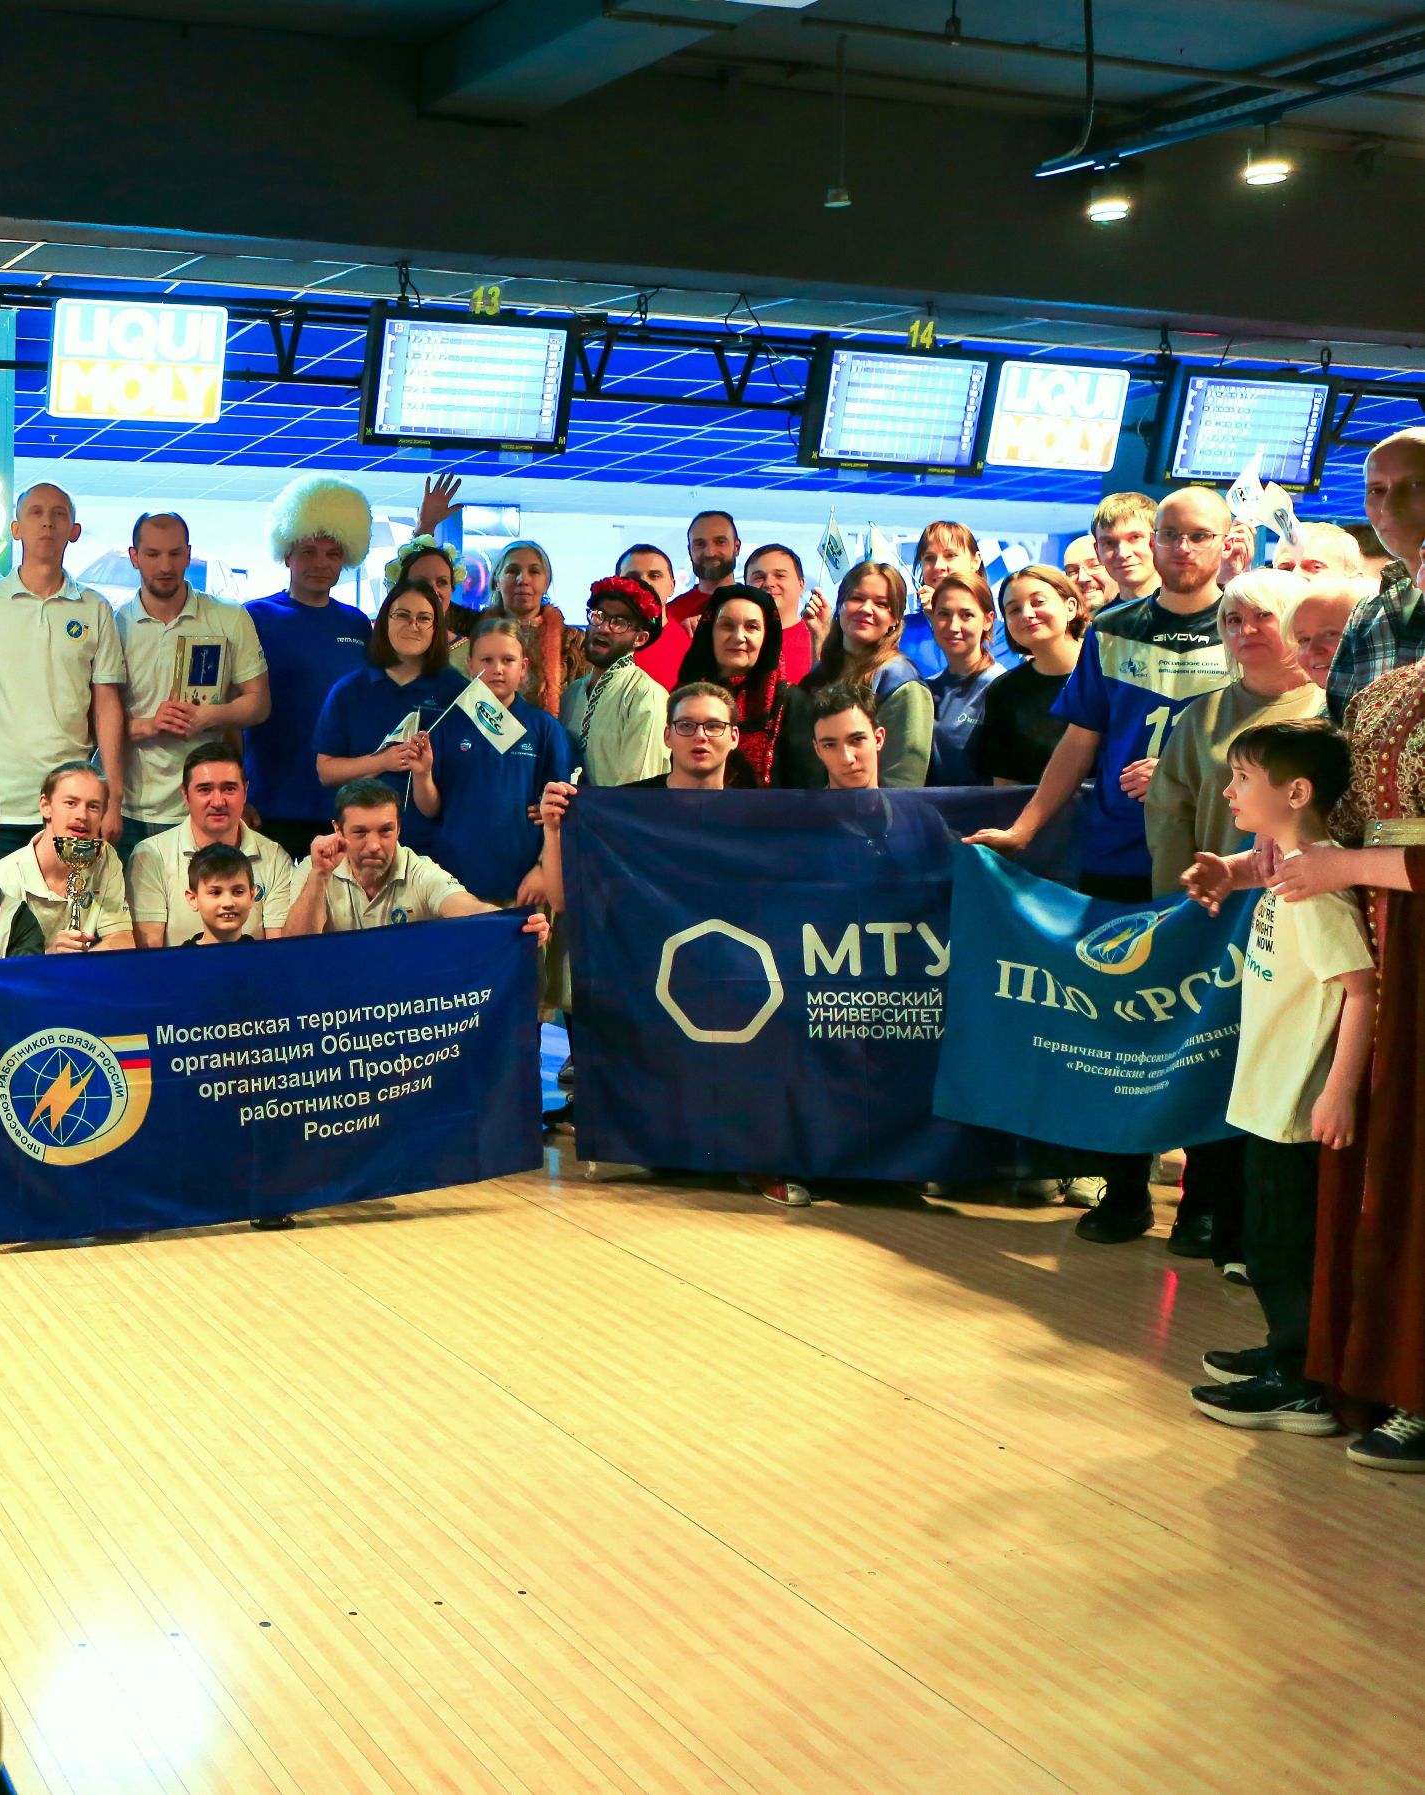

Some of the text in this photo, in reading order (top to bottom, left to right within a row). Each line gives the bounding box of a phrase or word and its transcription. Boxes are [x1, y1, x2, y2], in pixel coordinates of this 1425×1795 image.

[471, 285, 502, 316] 13
[64, 304, 219, 363] LIQUI
[909, 319, 935, 349] 14
[57, 362, 220, 420] MOLY
[1005, 366, 1120, 417] LIQUI
[993, 415, 1115, 470] MOLY
[1152, 632, 1211, 645] GIVOVA
[155, 987, 492, 1046] Московская территориальная
[806, 988, 944, 1007] МОСКОВСКИЙ
[806, 1007, 944, 1024] УНИВЕРСИТЕТ
[170, 1011, 480, 1076] организация Общественной
[809, 1024, 824, 1040] И
[1032, 1035, 1112, 1060] Первичная
[198, 1043, 461, 1102] организации Профсоюз
[1066, 1060, 1146, 1080] «Российские
[0, 1092, 41, 1155] ПРОФСОЮЗ
[58, 1034, 98, 1054] СВЯЗИ
[96, 1050, 125, 1098] РОССИИ
[239, 1074, 433, 1127] работников связи
[303, 1113, 381, 1142] России
